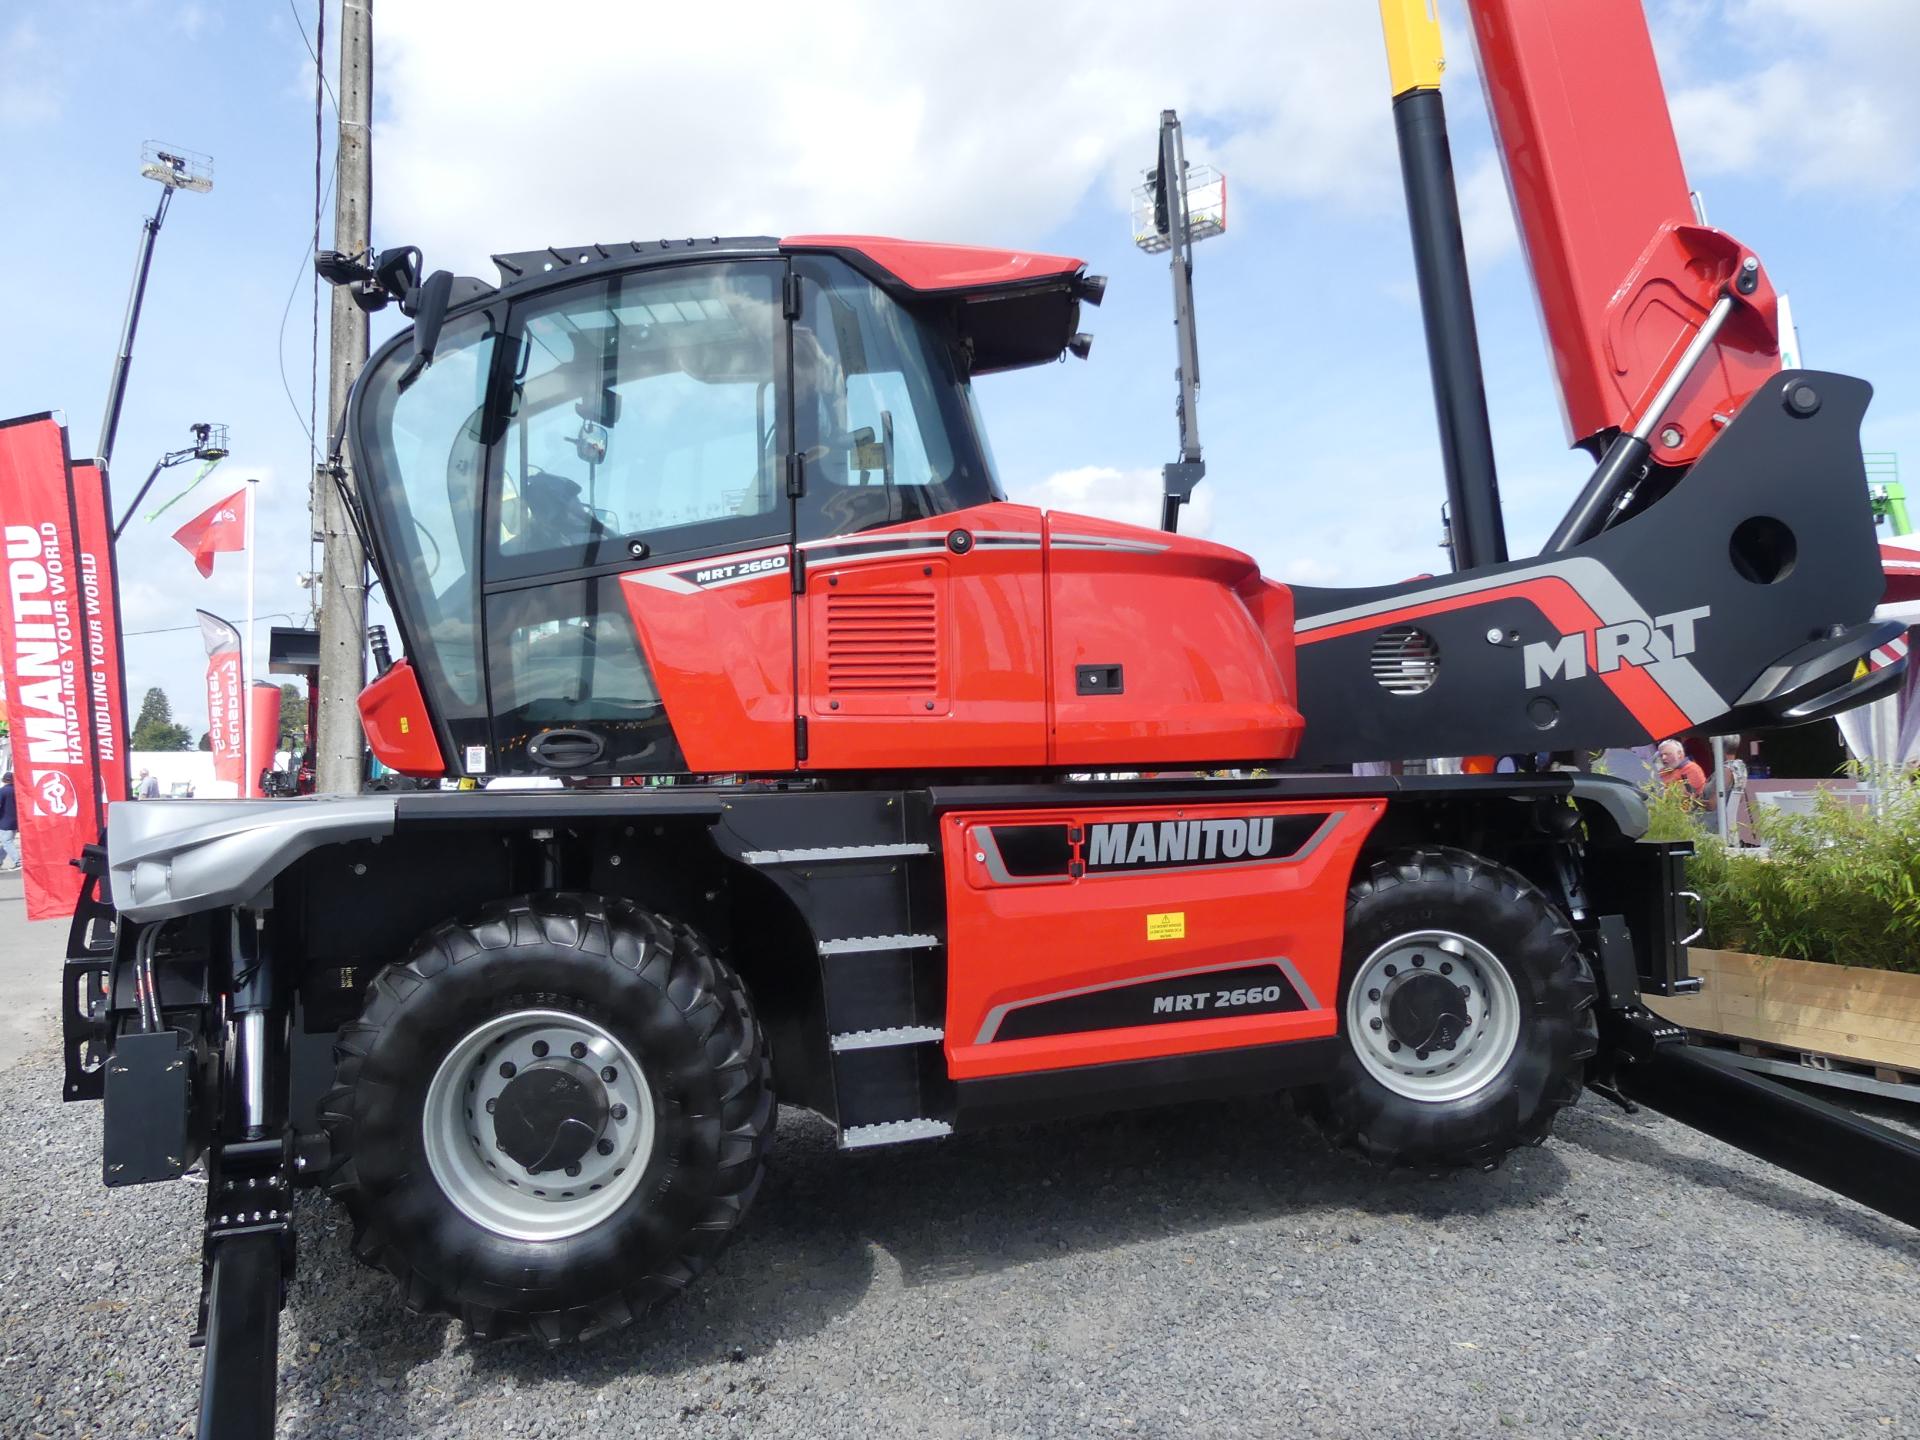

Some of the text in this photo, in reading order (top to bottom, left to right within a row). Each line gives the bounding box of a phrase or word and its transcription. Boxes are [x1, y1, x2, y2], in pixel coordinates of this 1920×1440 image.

[697, 557, 785, 582] MRT 2660
[5, 525, 70, 764] MANITOU
[40, 522, 83, 764] HANDLING YOUR WORLD
[81, 553, 114, 761] HANDLING YOUR WORLD
[1523, 605, 1711, 689] MRT
[1088, 818, 1274, 866] MANITOU
[1153, 986, 1280, 1013] MRT 2660
